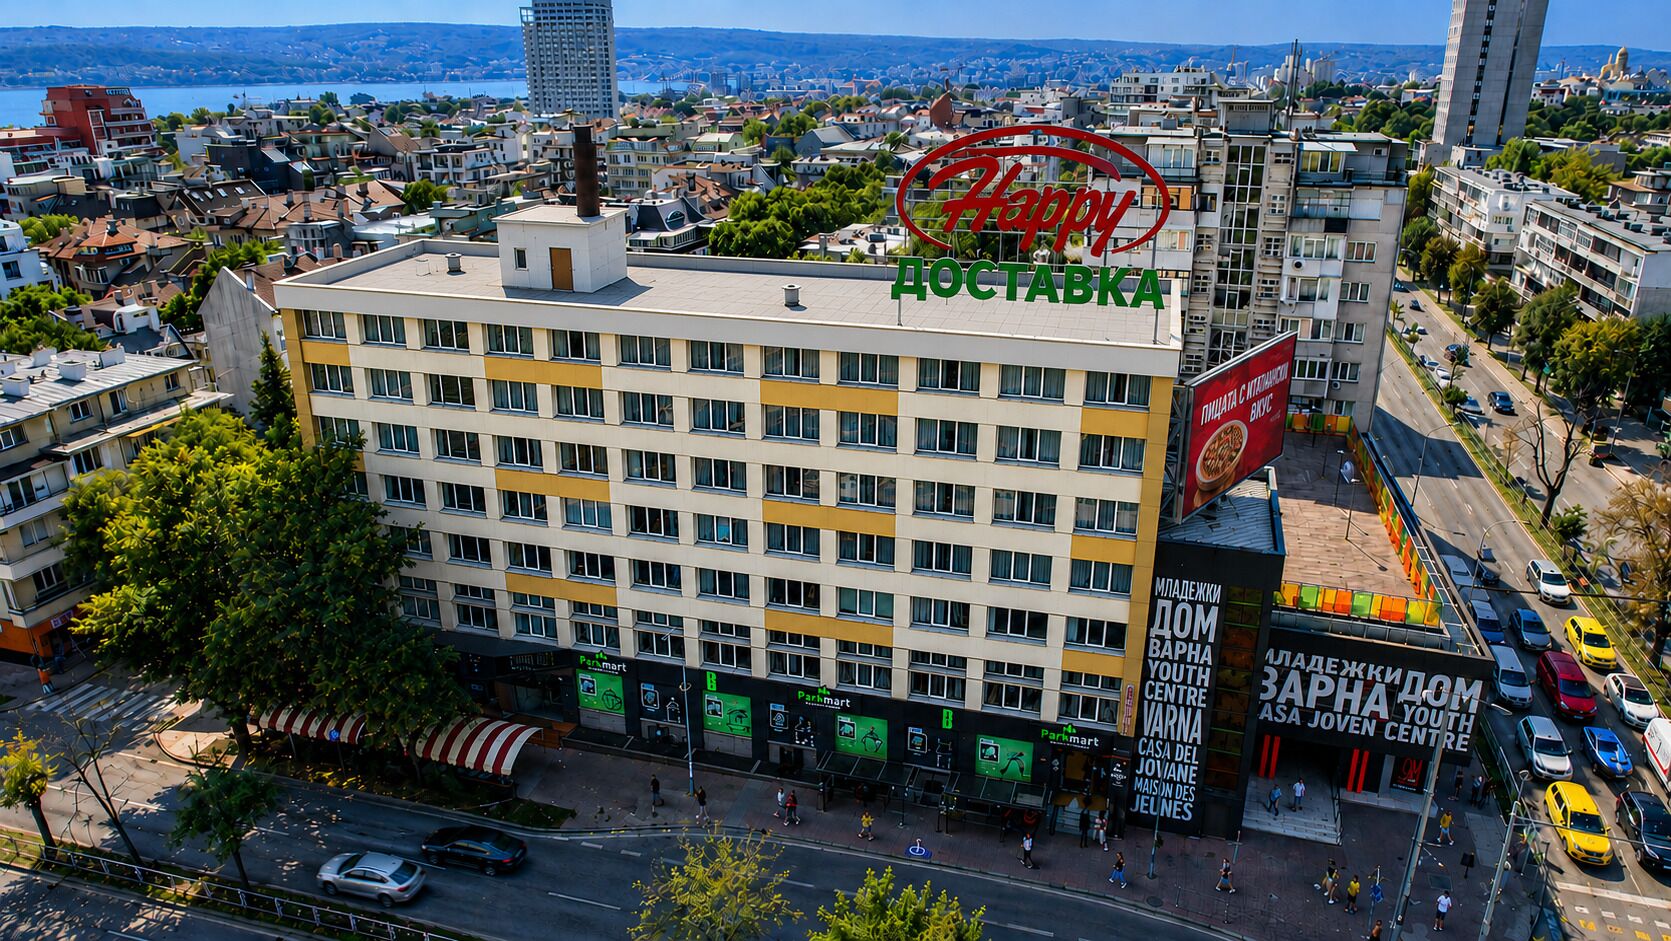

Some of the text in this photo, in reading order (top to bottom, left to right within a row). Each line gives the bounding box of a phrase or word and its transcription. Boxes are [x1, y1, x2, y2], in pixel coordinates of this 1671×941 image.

[928, 156, 1136, 257] Happy
[891, 257, 1165, 309] ДОСТАВКА
[1200, 389, 1237, 426] ПИЦАТА
[1239, 383, 1246, 405] С
[1250, 393, 1274, 423] ВКУС
[1155, 576, 1221, 604] МЛАДЕЖКИ
[1150, 599, 1219, 643] ДОМ
[1148, 638, 1213, 666] ВАРНА
[1147, 659, 1211, 687] YOUTH
[1144, 680, 1207, 708] CENTRE
[1397, 669, 1483, 714] ДОМ
[1143, 700, 1201, 745] VARNA
[1258, 701, 1471, 752] ASA JOVEN CENTRE
[1403, 703, 1476, 733] YOUTH
[1041, 728, 1099, 747] Parkmart
[1138, 737, 1199, 765] CASA DEL
[1134, 776, 1195, 802] MAISON DES
